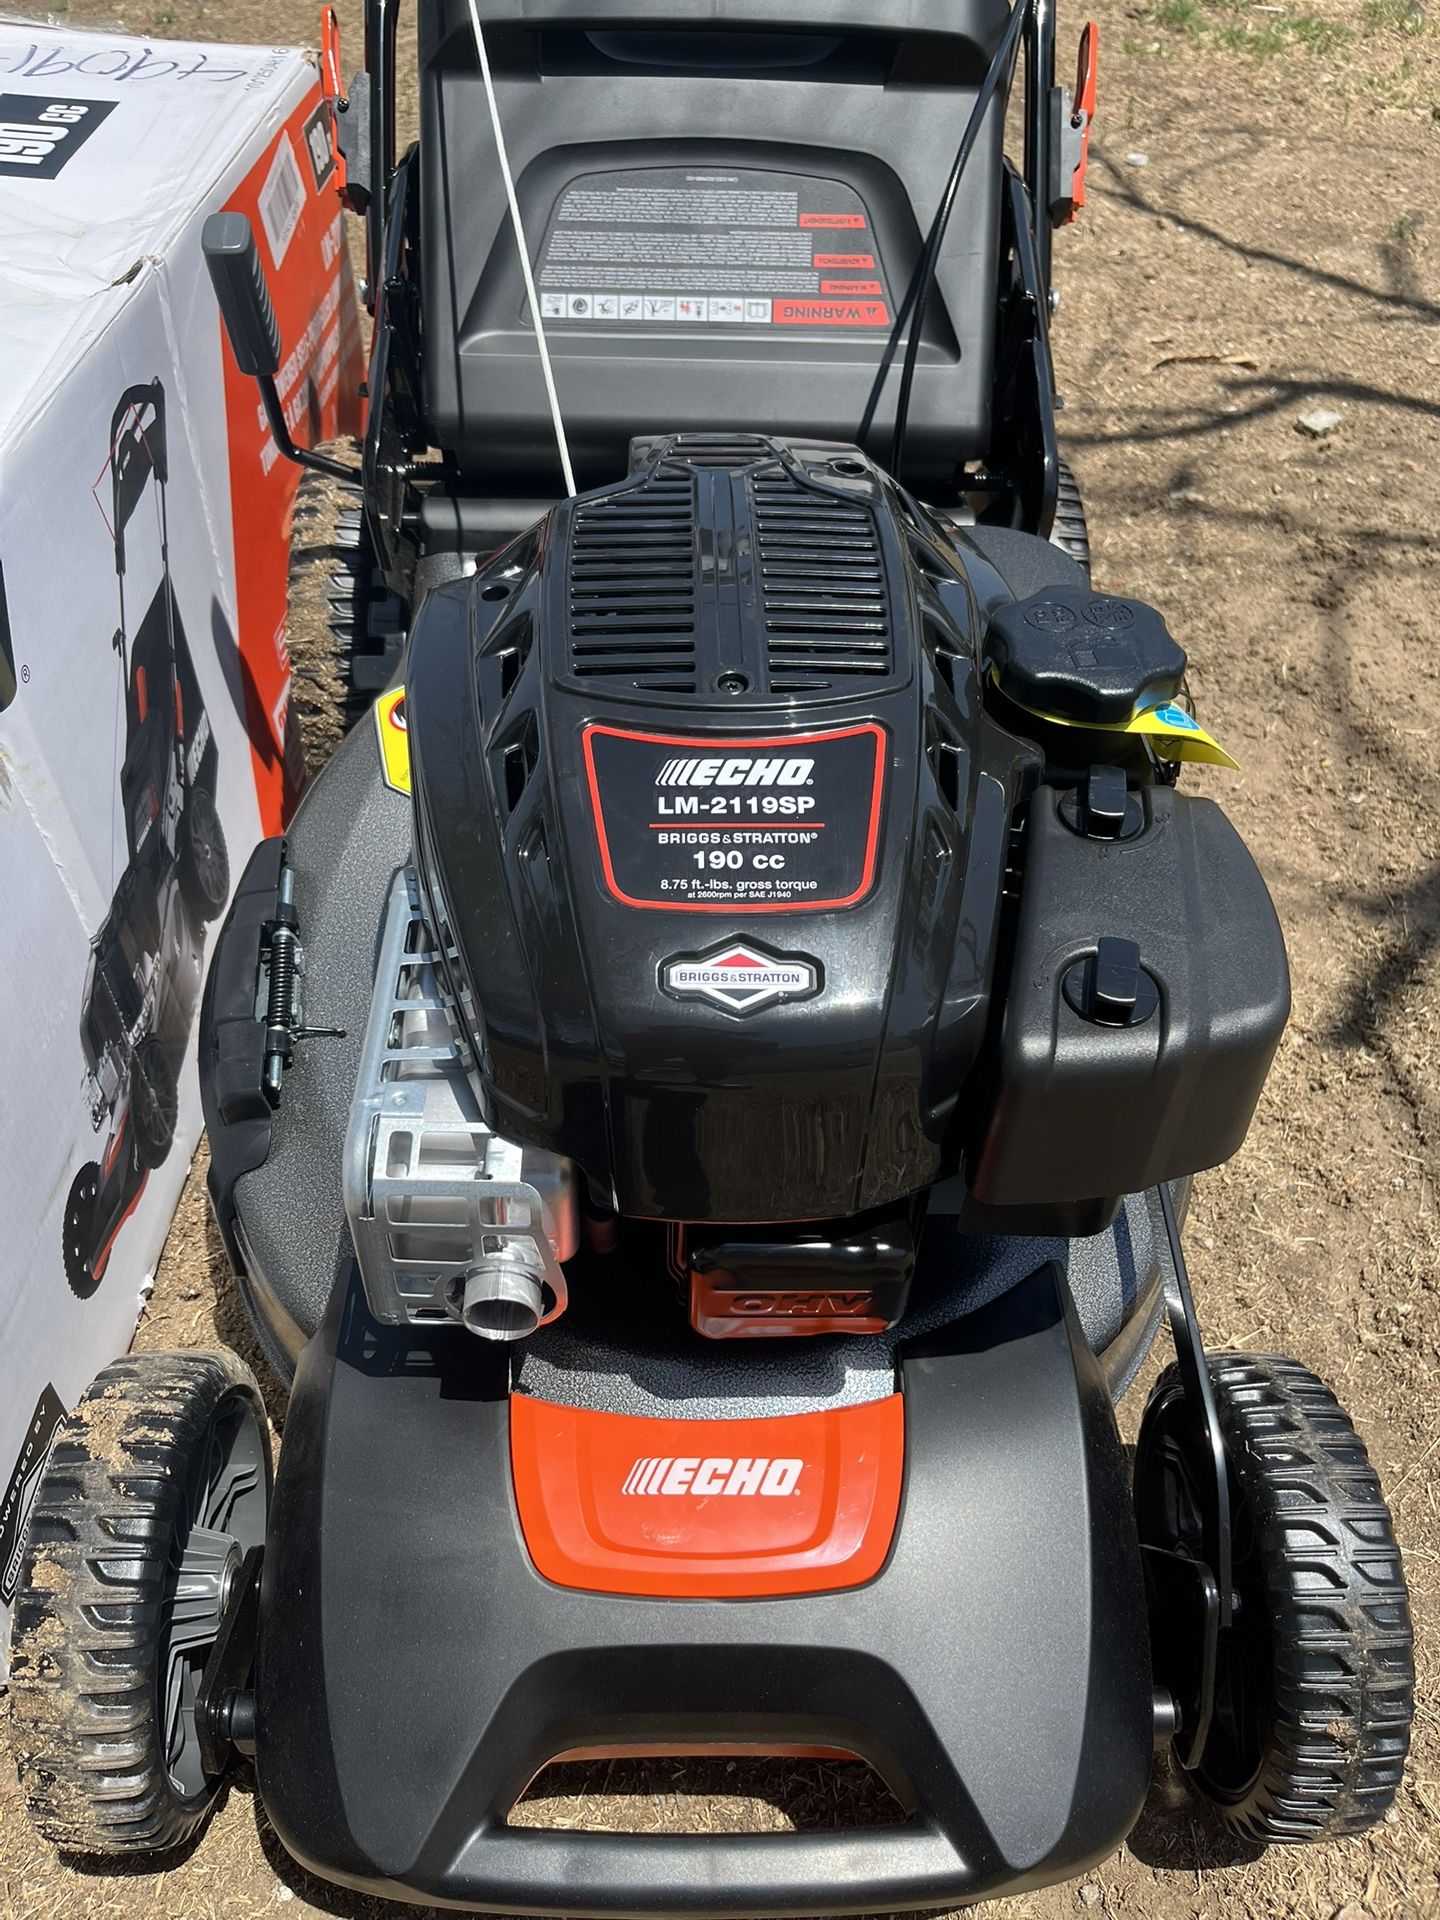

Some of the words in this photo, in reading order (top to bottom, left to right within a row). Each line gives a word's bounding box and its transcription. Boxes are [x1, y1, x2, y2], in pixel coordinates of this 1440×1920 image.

[784, 306, 861, 319] WARNING
[658, 796, 815, 815] LM-2119SP
[693, 850, 743, 869] 190
[752, 854, 785, 869] cc
[661, 879, 688, 890] 8.75
[691, 879, 733, 890] ft.-lbs.
[736, 882, 772, 893] gross
[775, 880, 818, 893] torque
[688, 890, 696, 898] at
[697, 890, 731, 900] 2600rpm
[734, 892, 747, 900] per
[749, 890, 766, 898] SAE
[768, 890, 791, 898] J1940
